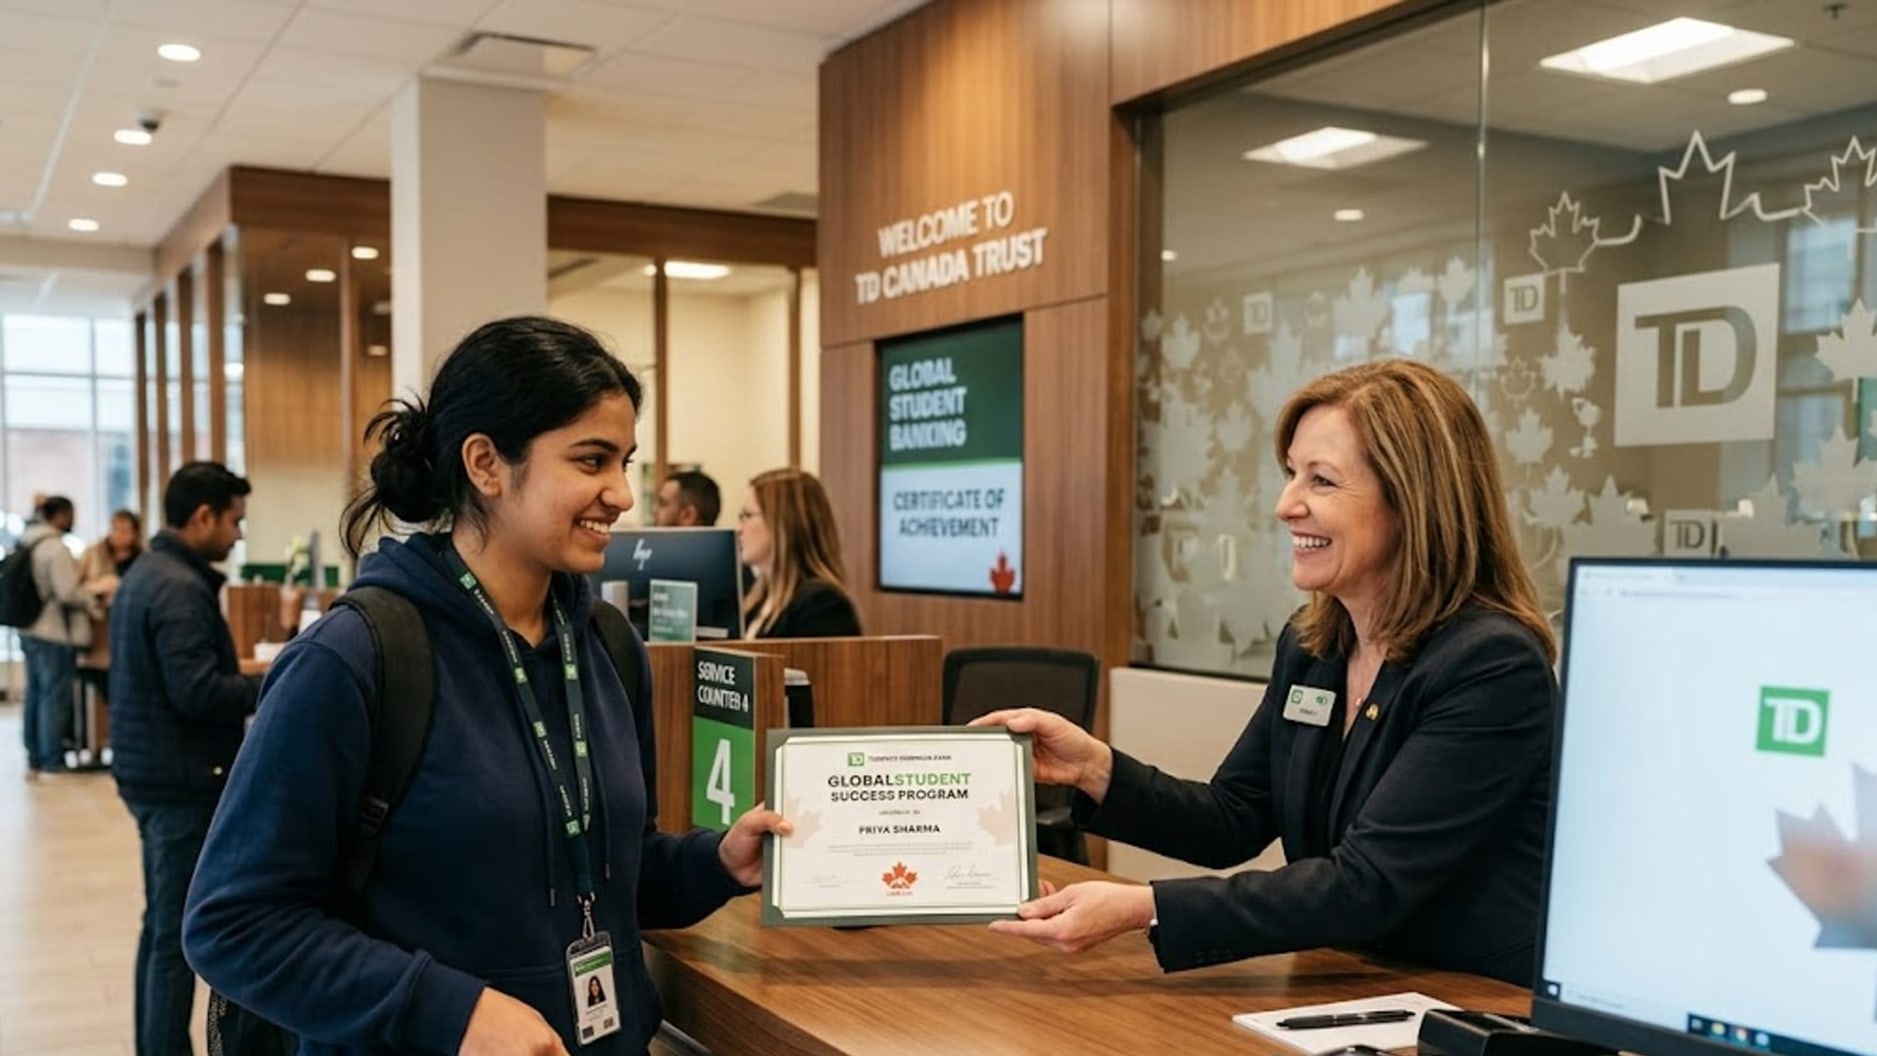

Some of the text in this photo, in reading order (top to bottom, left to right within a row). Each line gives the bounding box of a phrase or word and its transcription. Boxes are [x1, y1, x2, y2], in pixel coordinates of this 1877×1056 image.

[877, 190, 1014, 258] WELCOME TO
[855, 228, 1048, 304] TD CANADA TRUST
[1509, 284, 1539, 313] TD
[1634, 305, 1757, 409] TD
[889, 357, 957, 391] GLOBAL
[889, 387, 967, 421] STUDENT
[889, 420, 967, 451] BANKING
[894, 487, 1005, 511] CERTIFICATE OF
[900, 517, 999, 538] ACHIEVEMENT
[1669, 520, 1705, 549] TD
[1763, 695, 1823, 745] TD
[706, 738, 735, 826] 4
[830, 788, 970, 802] SUCCESS PROGRAM
[858, 824, 941, 836] PRIYA SHARMA
